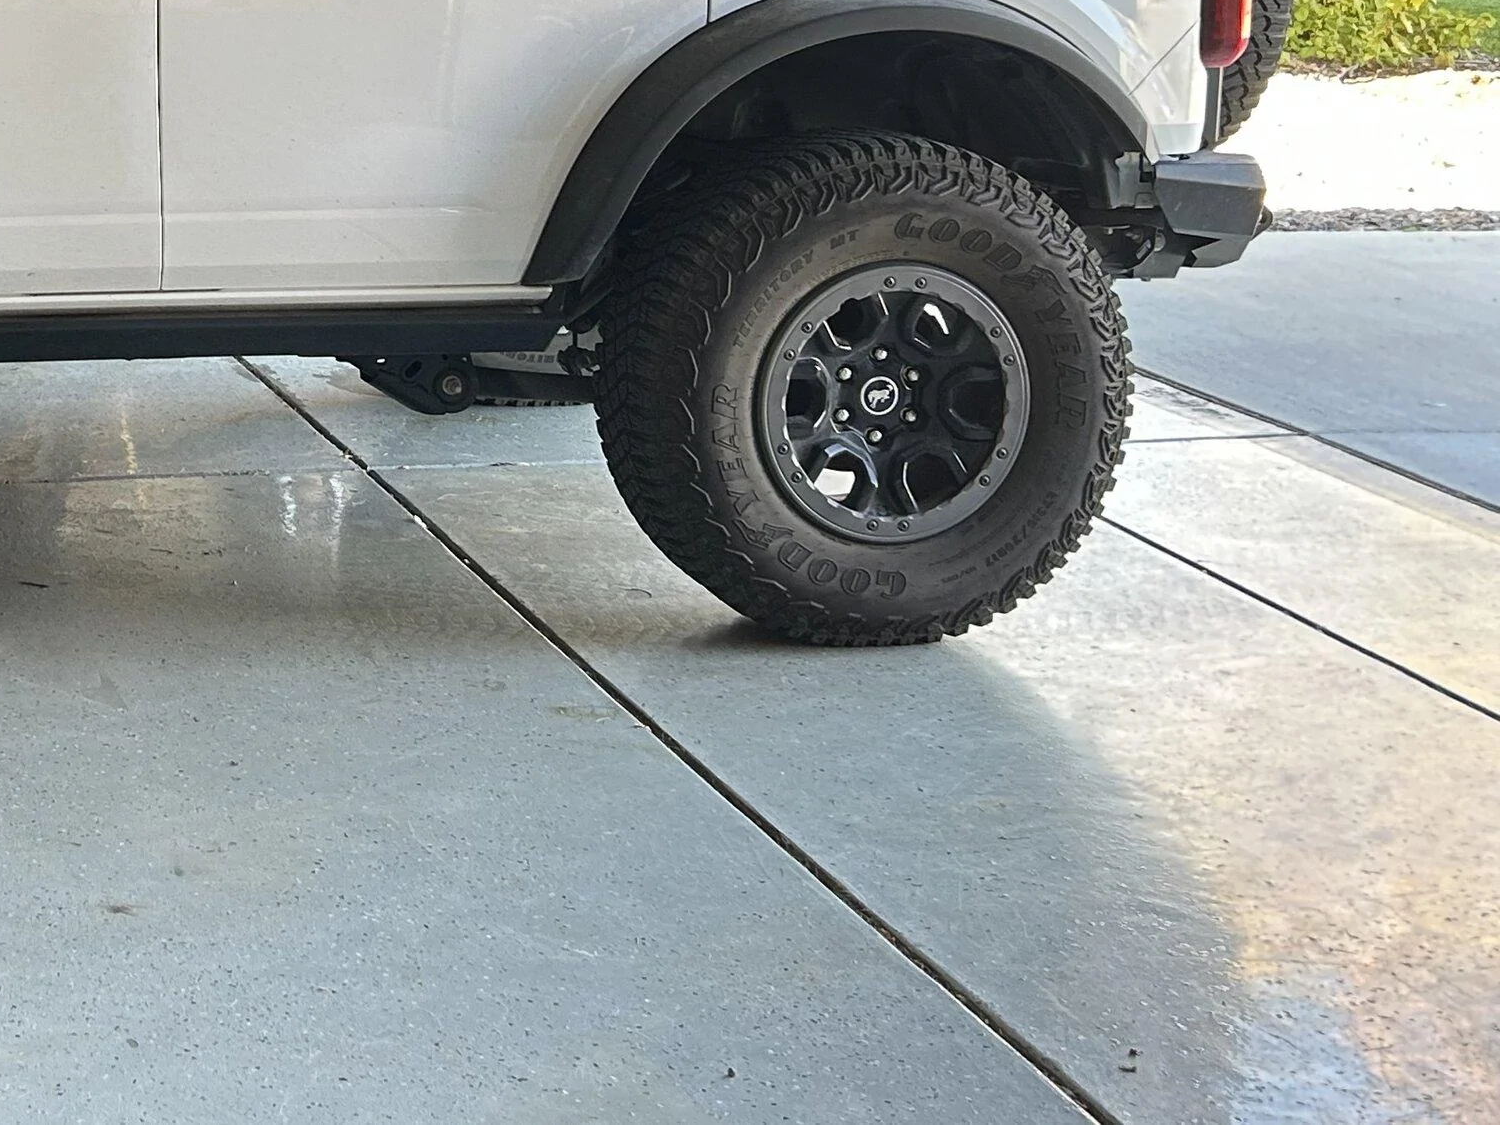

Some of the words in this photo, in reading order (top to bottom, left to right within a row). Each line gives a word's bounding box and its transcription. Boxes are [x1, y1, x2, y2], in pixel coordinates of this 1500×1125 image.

[732, 248, 815, 349] TERRITORY
[829, 228, 860, 250] MT
[894, 212, 1088, 429] GOODYEAR
[711, 382, 908, 598] GOODYEAR
